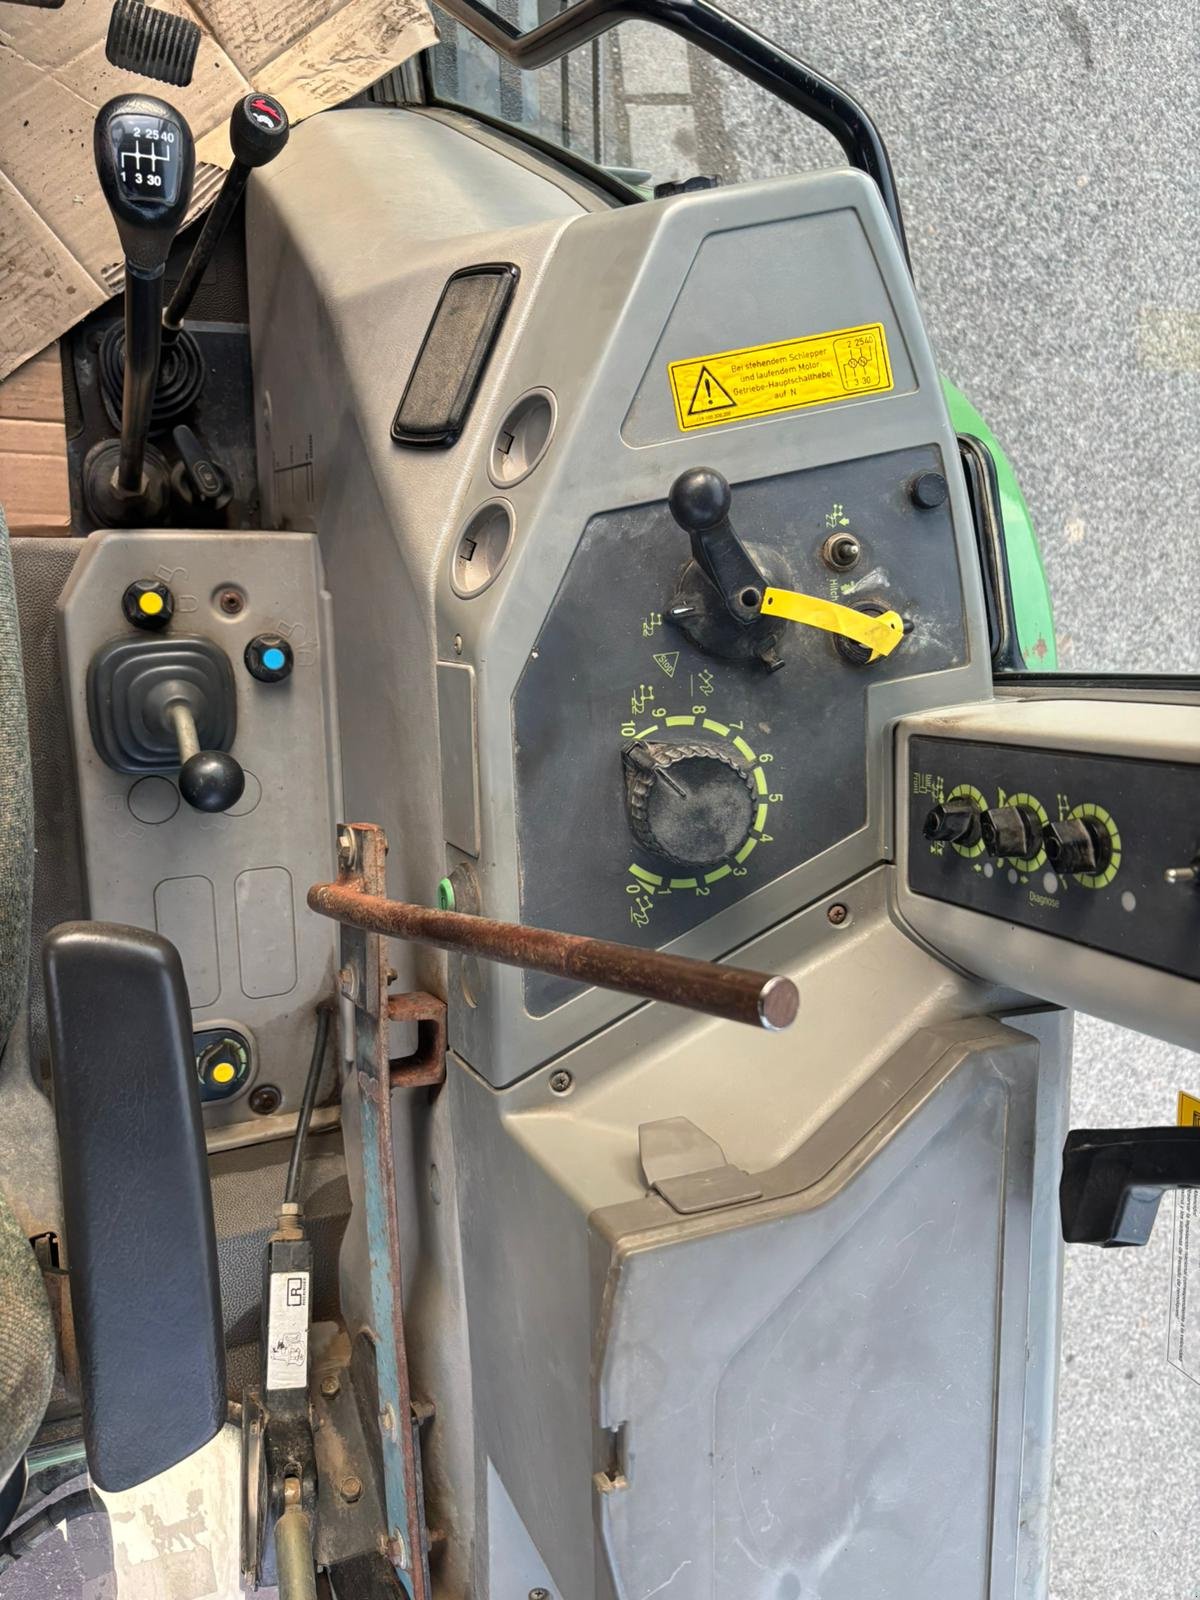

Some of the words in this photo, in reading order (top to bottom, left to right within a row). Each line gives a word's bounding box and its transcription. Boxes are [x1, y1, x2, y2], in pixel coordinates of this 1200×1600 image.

[133, 127, 141, 137] 2
[146, 129, 159, 139] 25
[161, 132, 174, 142] 40
[120, 172, 126, 182] 1
[135, 173, 142, 183] 3
[147, 175, 161, 186] 30
[846, 340, 852, 349] 2
[854, 337, 865, 347] 25
[864, 335, 874, 344] 40
[731, 364, 744, 374] Bei
[745, 356, 788, 370] stehendem
[789, 348, 828, 362] Schlepper
[740, 374, 755, 383] und
[756, 366, 797, 379] laufendem
[854, 377, 860, 386] 3
[861, 375, 871, 385] 30
[733, 369, 834, 396] Getriebe-Hauptschalthebel
[774, 390, 787, 399] auf
[790, 387, 797, 397] N
[829, 579, 840, 602] Hitch
[658, 653, 674, 673] Stop
[651, 707, 667, 719] 9
[692, 705, 707, 715] 8
[621, 720, 637, 737] 10
[729, 720, 745, 731] 7
[758, 753, 774, 764] 6
[768, 793, 784, 803] 5
[759, 833, 774, 843] 4
[733, 866, 748, 877] 3
[625, 883, 641, 894] 0
[657, 888, 673, 896] 1
[696, 887, 711, 897] 2
[1029, 889, 1061, 909] Diagnose
